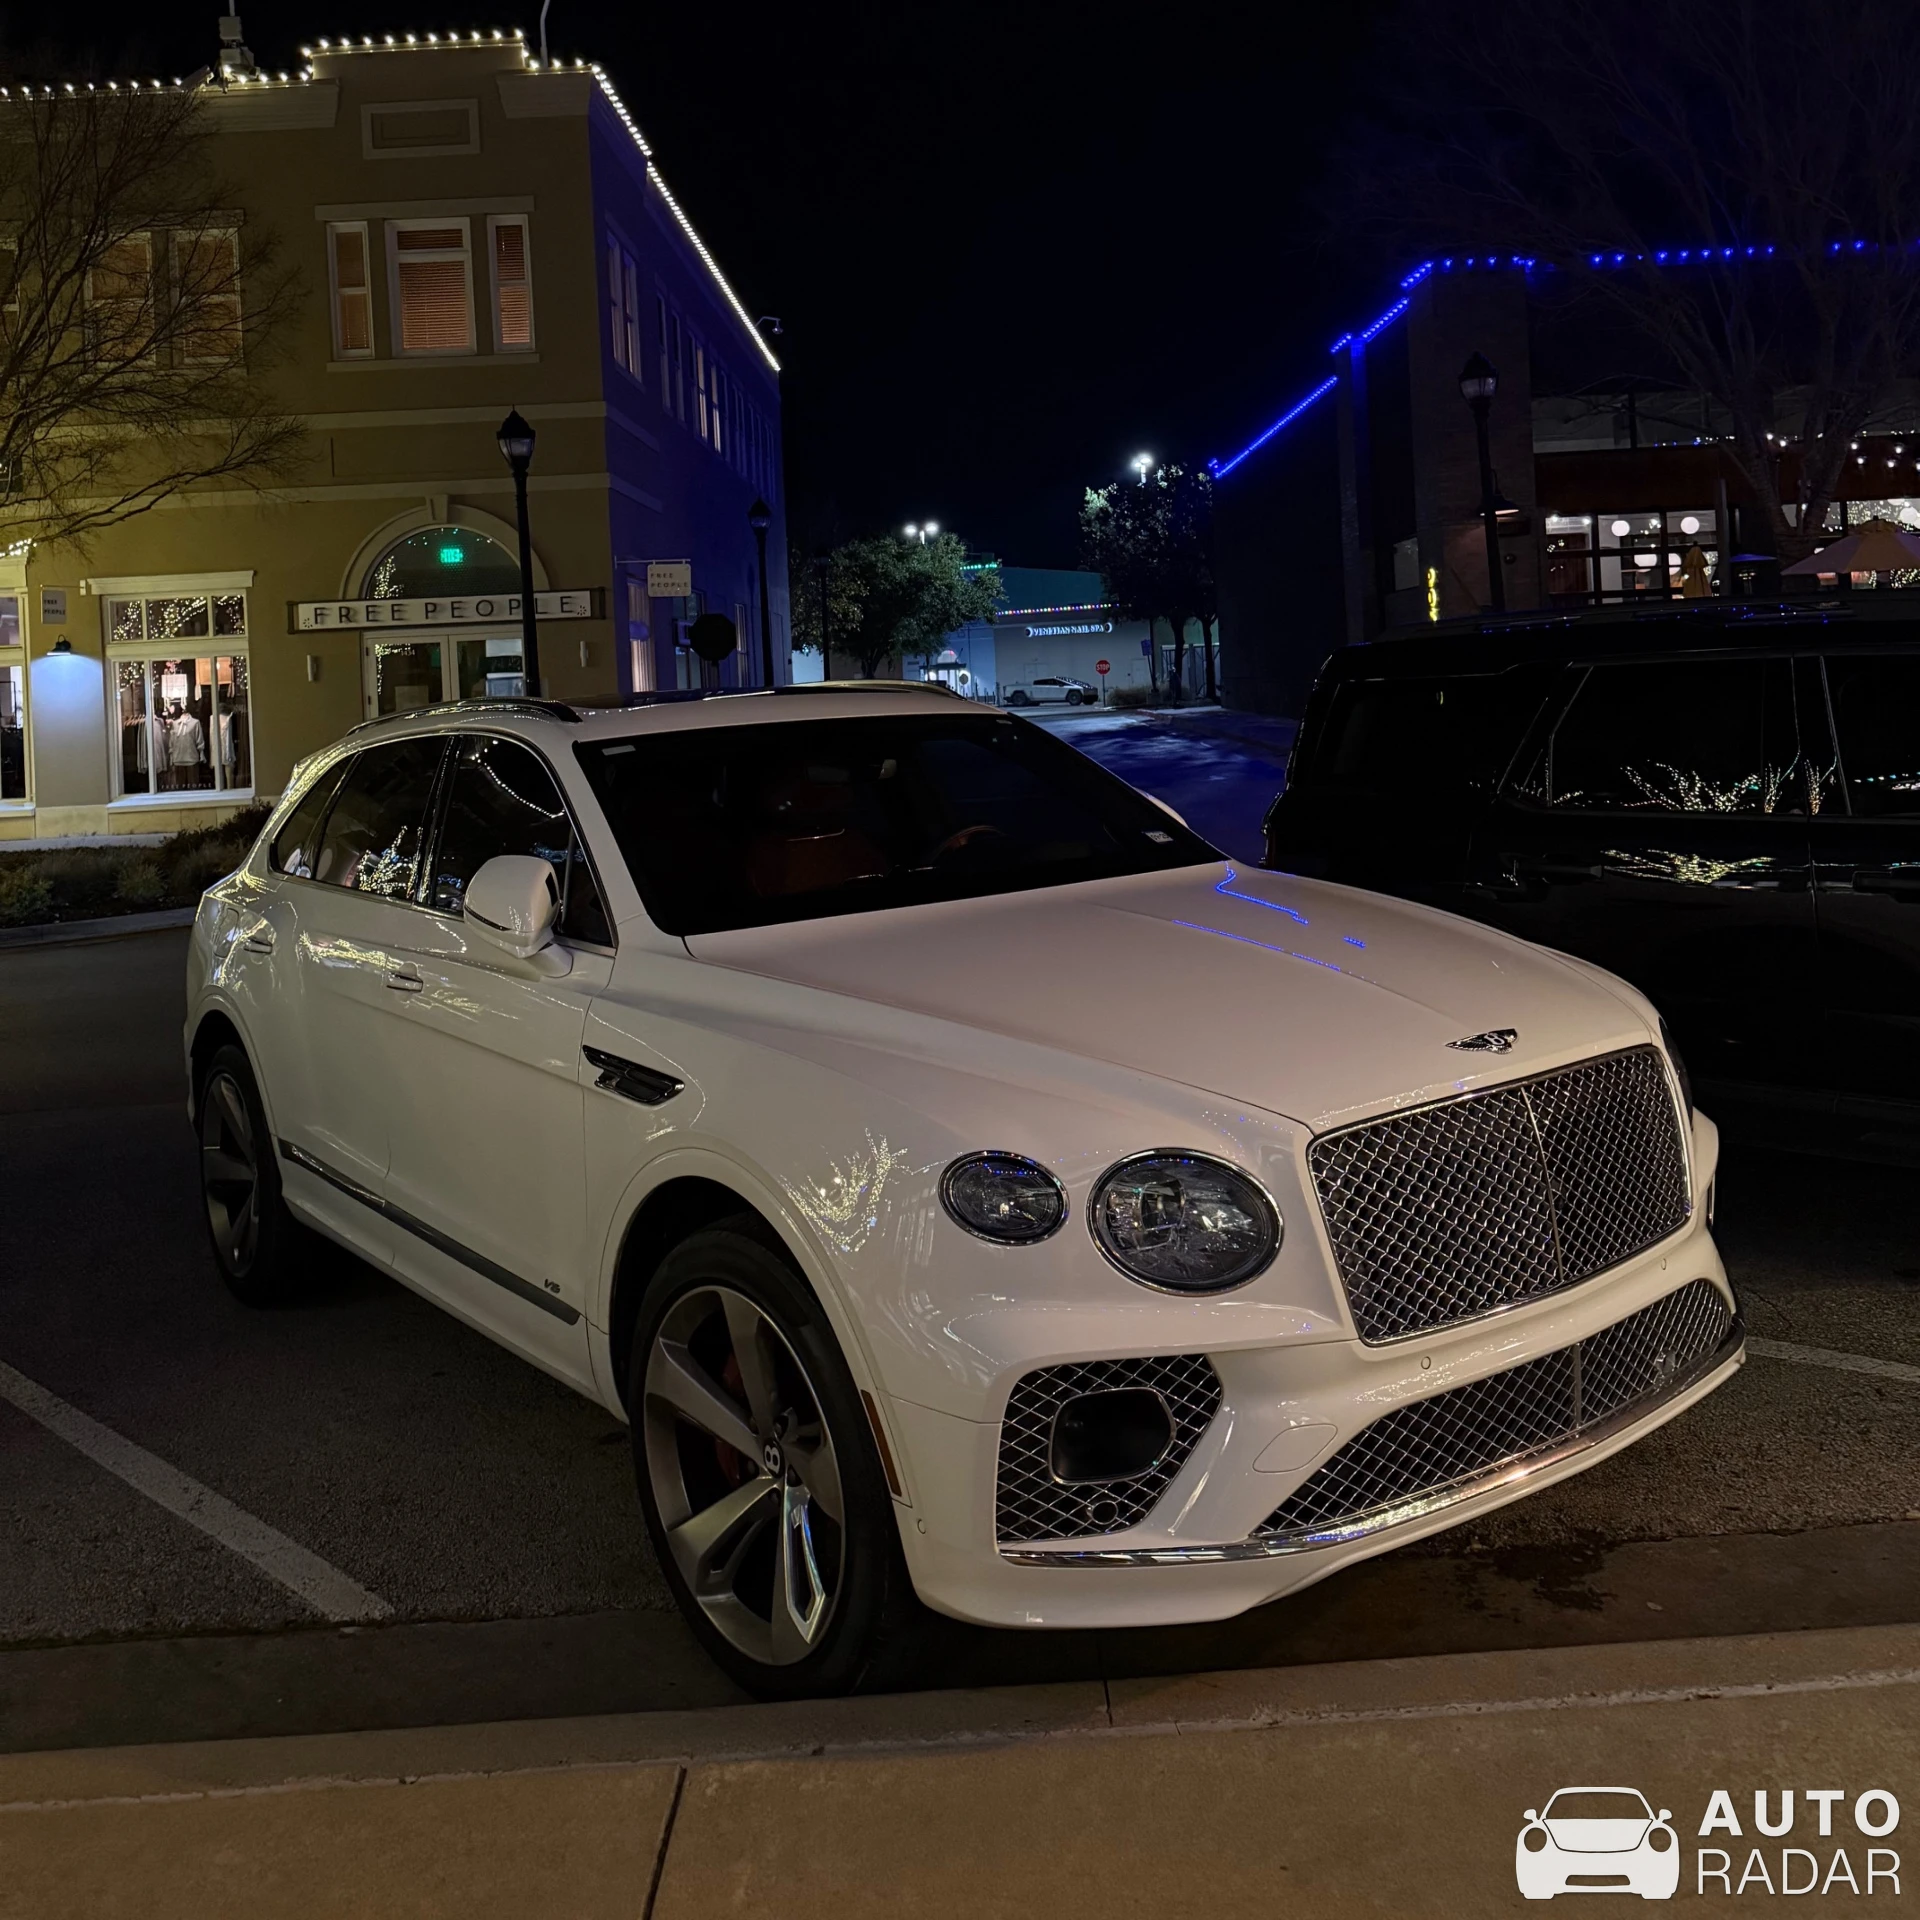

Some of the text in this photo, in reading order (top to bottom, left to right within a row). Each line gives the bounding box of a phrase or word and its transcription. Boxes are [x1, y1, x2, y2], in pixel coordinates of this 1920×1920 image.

[313, 595, 574, 625] FREE PEOPLE
[1033, 624, 1104, 636] VENETIAN NAIL SPA
[764, 1444, 781, 1474] B
